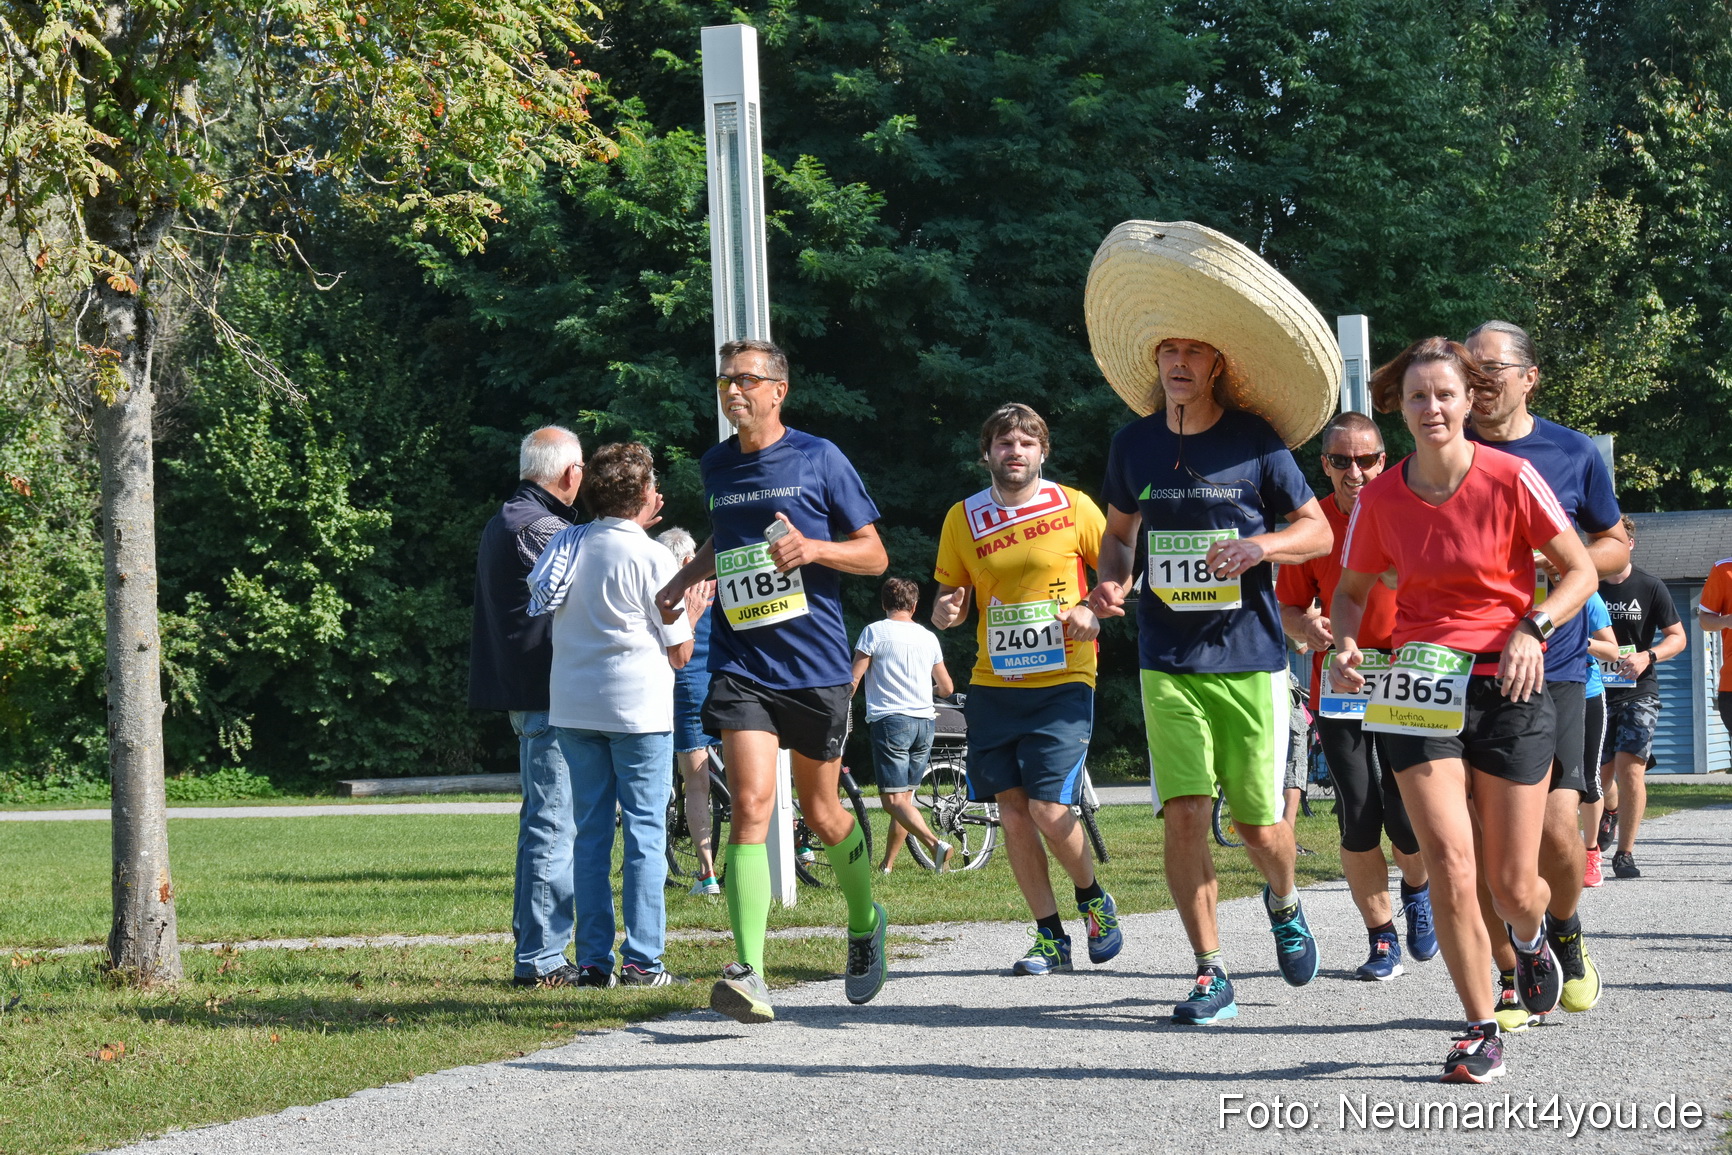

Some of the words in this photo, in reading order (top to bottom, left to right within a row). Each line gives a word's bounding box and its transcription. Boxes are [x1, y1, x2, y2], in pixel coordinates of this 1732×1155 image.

[714, 493, 745, 508] GOSSEN
[747, 486, 802, 502] METRAWATT
[1151, 488, 1185, 499] GOSSEN
[1188, 487, 1242, 499] METRAWATT
[975, 533, 1019, 559] MAX
[1023, 515, 1074, 540] BÖGL
[720, 542, 775, 573] BOC
[726, 570, 792, 603] 1183
[1171, 590, 1217, 602] ARMIN
[738, 599, 789, 621] JÜRGEN
[992, 604, 1051, 624] BOCK
[995, 626, 1052, 651] 2401
[1004, 654, 1047, 667] MARCO
[1395, 646, 1463, 672] OCK
[1382, 673, 1453, 705] 1365
[1341, 701, 1366, 711] PET
[1389, 707, 1425, 722] Martina
